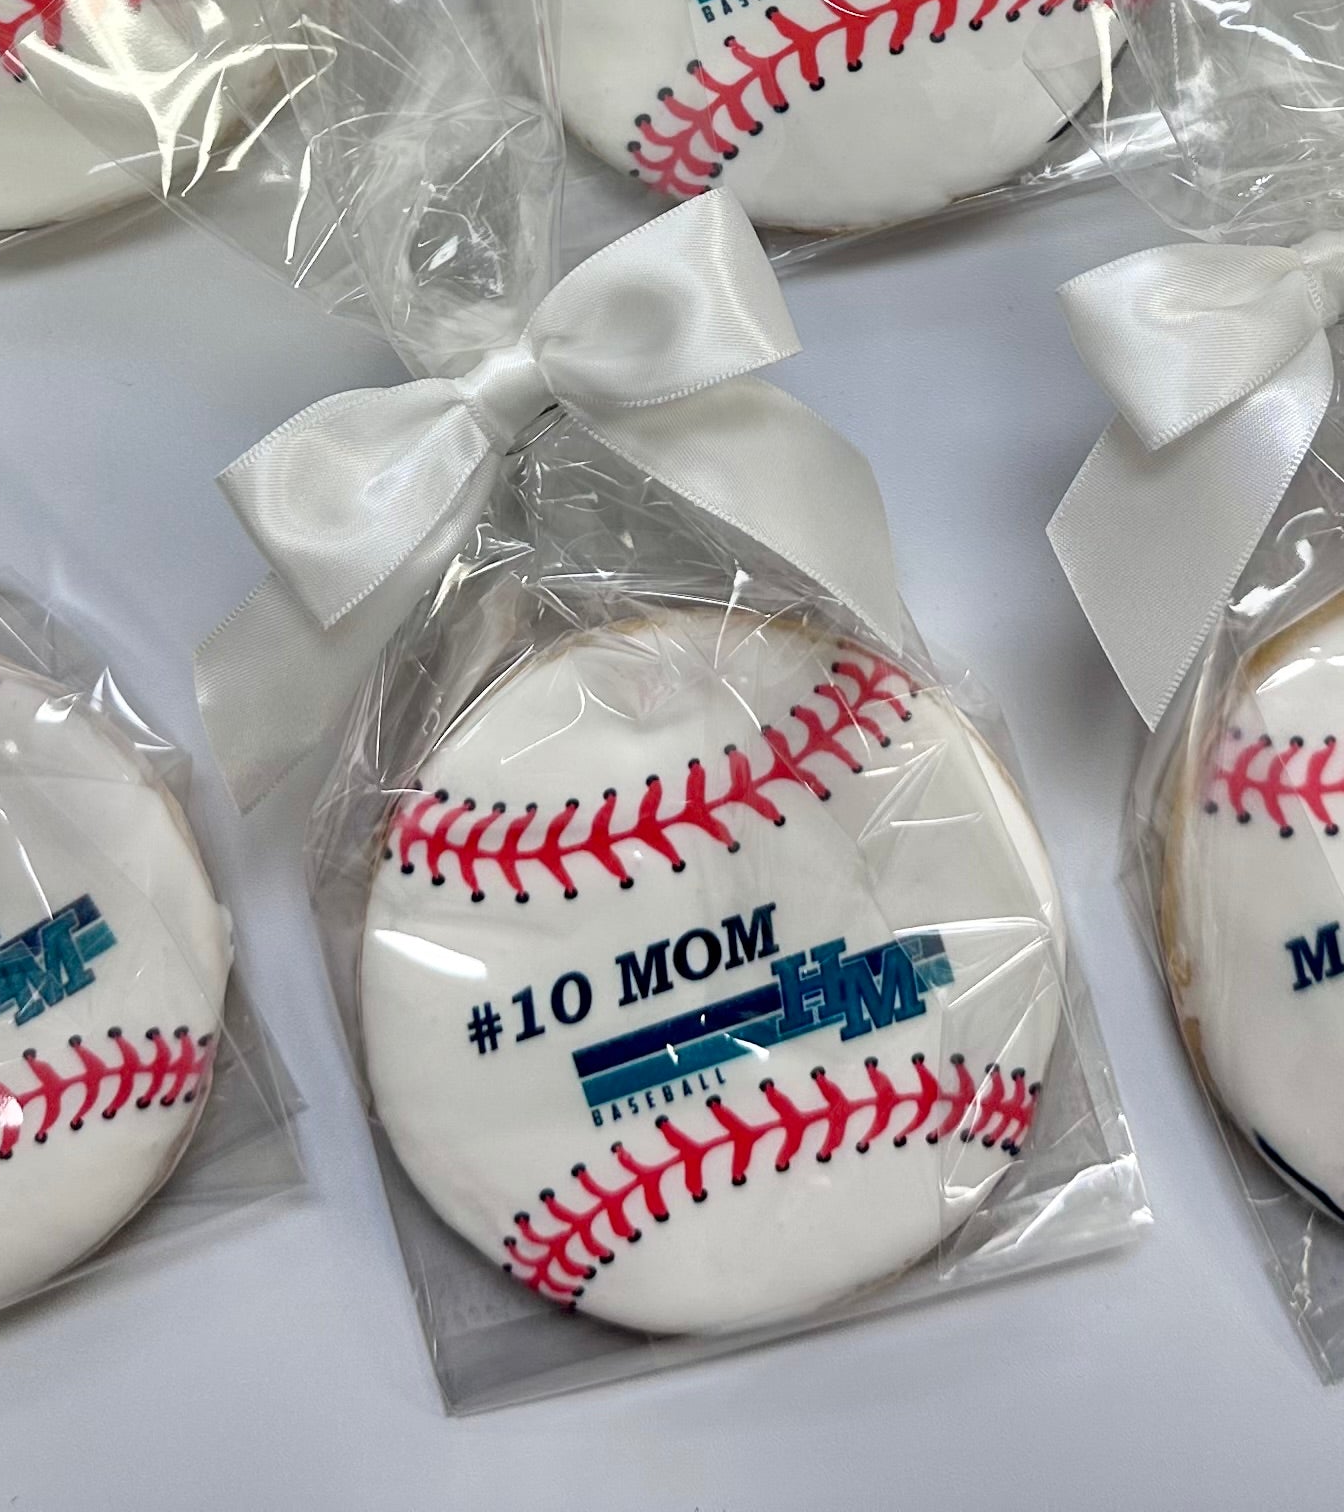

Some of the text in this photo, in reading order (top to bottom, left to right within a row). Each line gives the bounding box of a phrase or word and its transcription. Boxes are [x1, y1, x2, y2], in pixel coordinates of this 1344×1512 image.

[467, 902, 779, 1055] #10 MOM
[771, 937, 927, 1042] HM
[592, 1066, 728, 1127] BASEBALL
